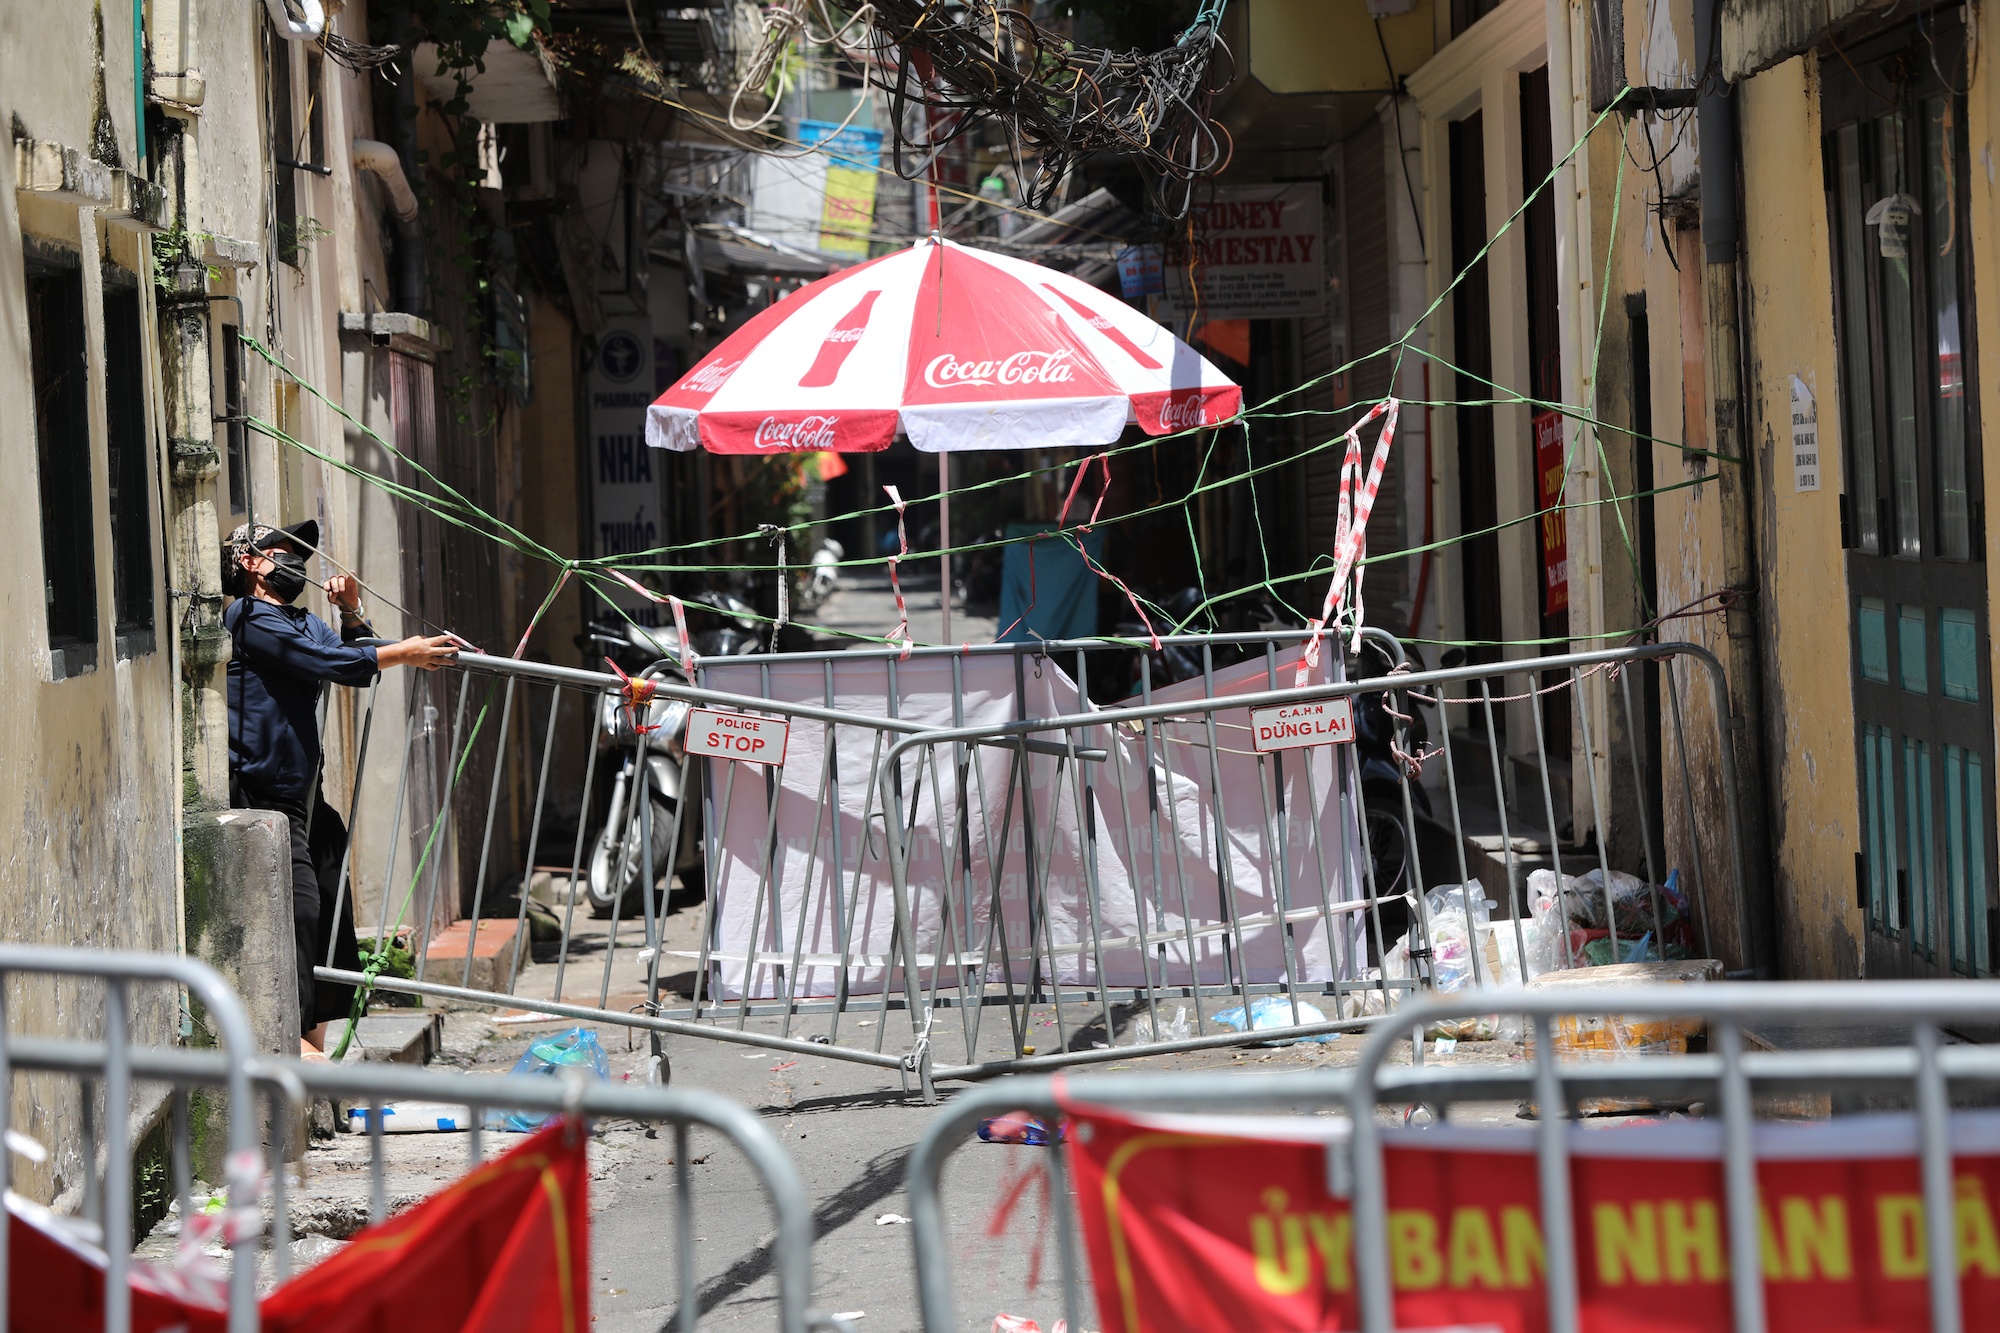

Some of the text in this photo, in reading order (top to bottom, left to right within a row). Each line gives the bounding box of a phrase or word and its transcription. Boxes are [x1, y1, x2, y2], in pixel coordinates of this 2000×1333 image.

[924, 348, 1075, 389] Coca-Cola
[1159, 394, 1209, 430] Coca-Cola
[754, 415, 840, 449] Coca-Cola
[716, 717, 761, 731] POLICE
[1279, 705, 1323, 719] C.A.H.N
[706, 731, 765, 753] STOP
[1260, 717, 1346, 740] DỪNG LẠI
[1388, 1205, 1548, 1291] BAN
